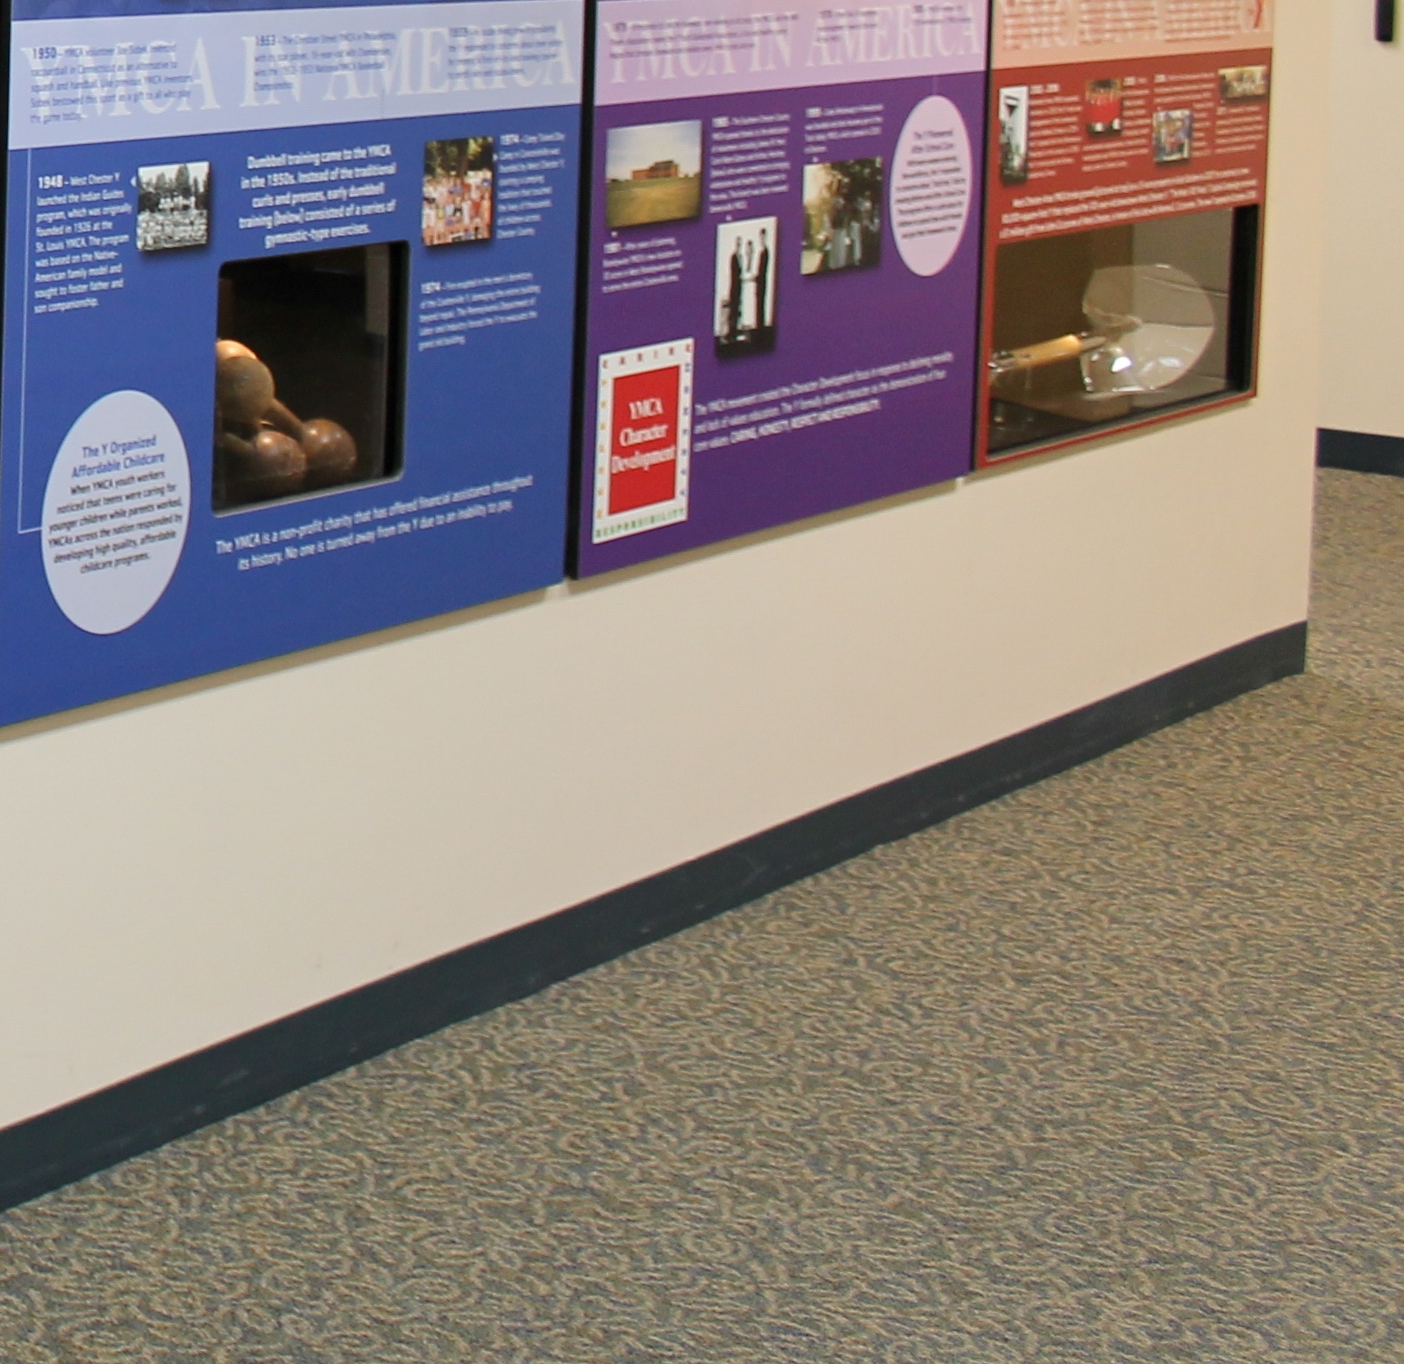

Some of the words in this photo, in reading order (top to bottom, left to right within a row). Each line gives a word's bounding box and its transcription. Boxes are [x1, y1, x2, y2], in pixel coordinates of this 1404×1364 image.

[21, 37, 221, 122] YMCA
[239, 35, 306, 110] IN
[321, 19, 577, 102] AMERICA
[604, 13, 736, 84] YMCA
[750, 11, 793, 70] IN
[805, 0, 983, 67] AMERICA
[628, 397, 664, 420] YMCA
